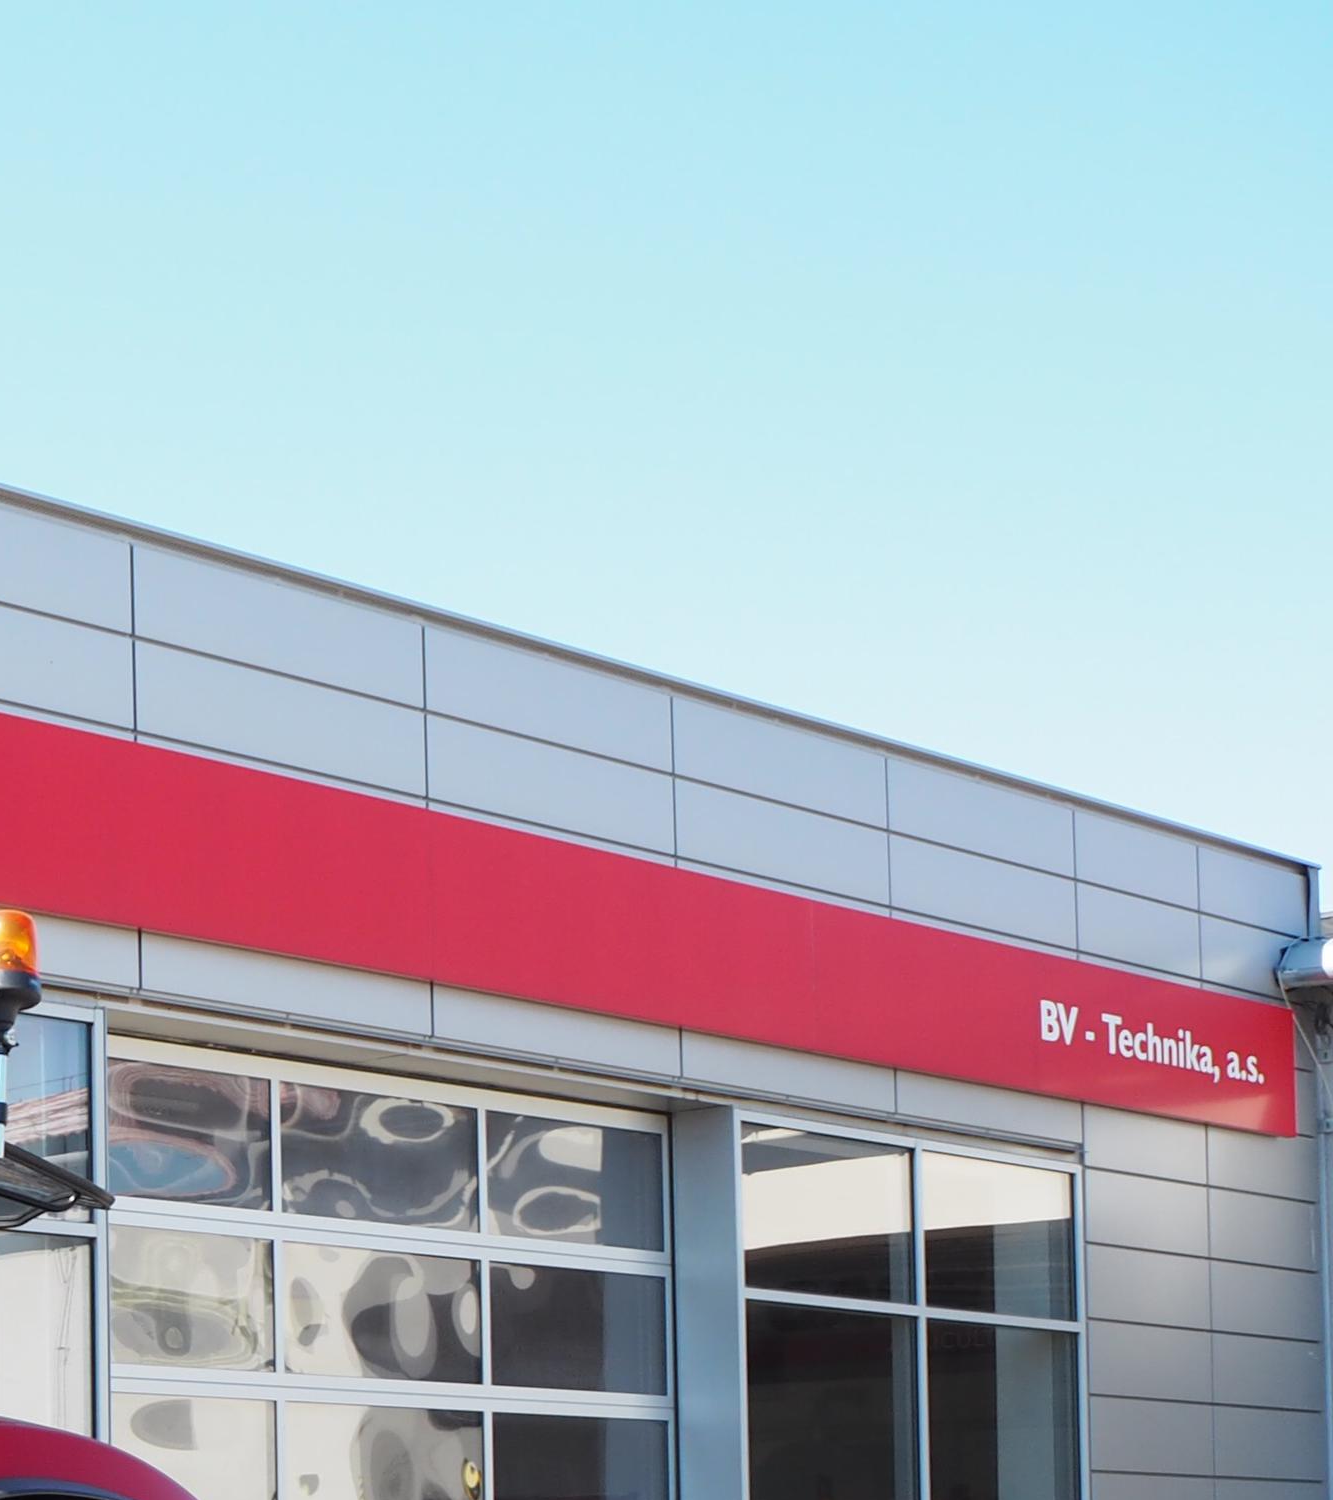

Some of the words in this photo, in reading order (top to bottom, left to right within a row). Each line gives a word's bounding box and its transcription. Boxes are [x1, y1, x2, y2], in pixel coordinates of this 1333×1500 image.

[1040, 999, 1079, 1045] BV
[1101, 1012, 1220, 1083] Technika,
[1226, 1051, 1265, 1084] a.s.
